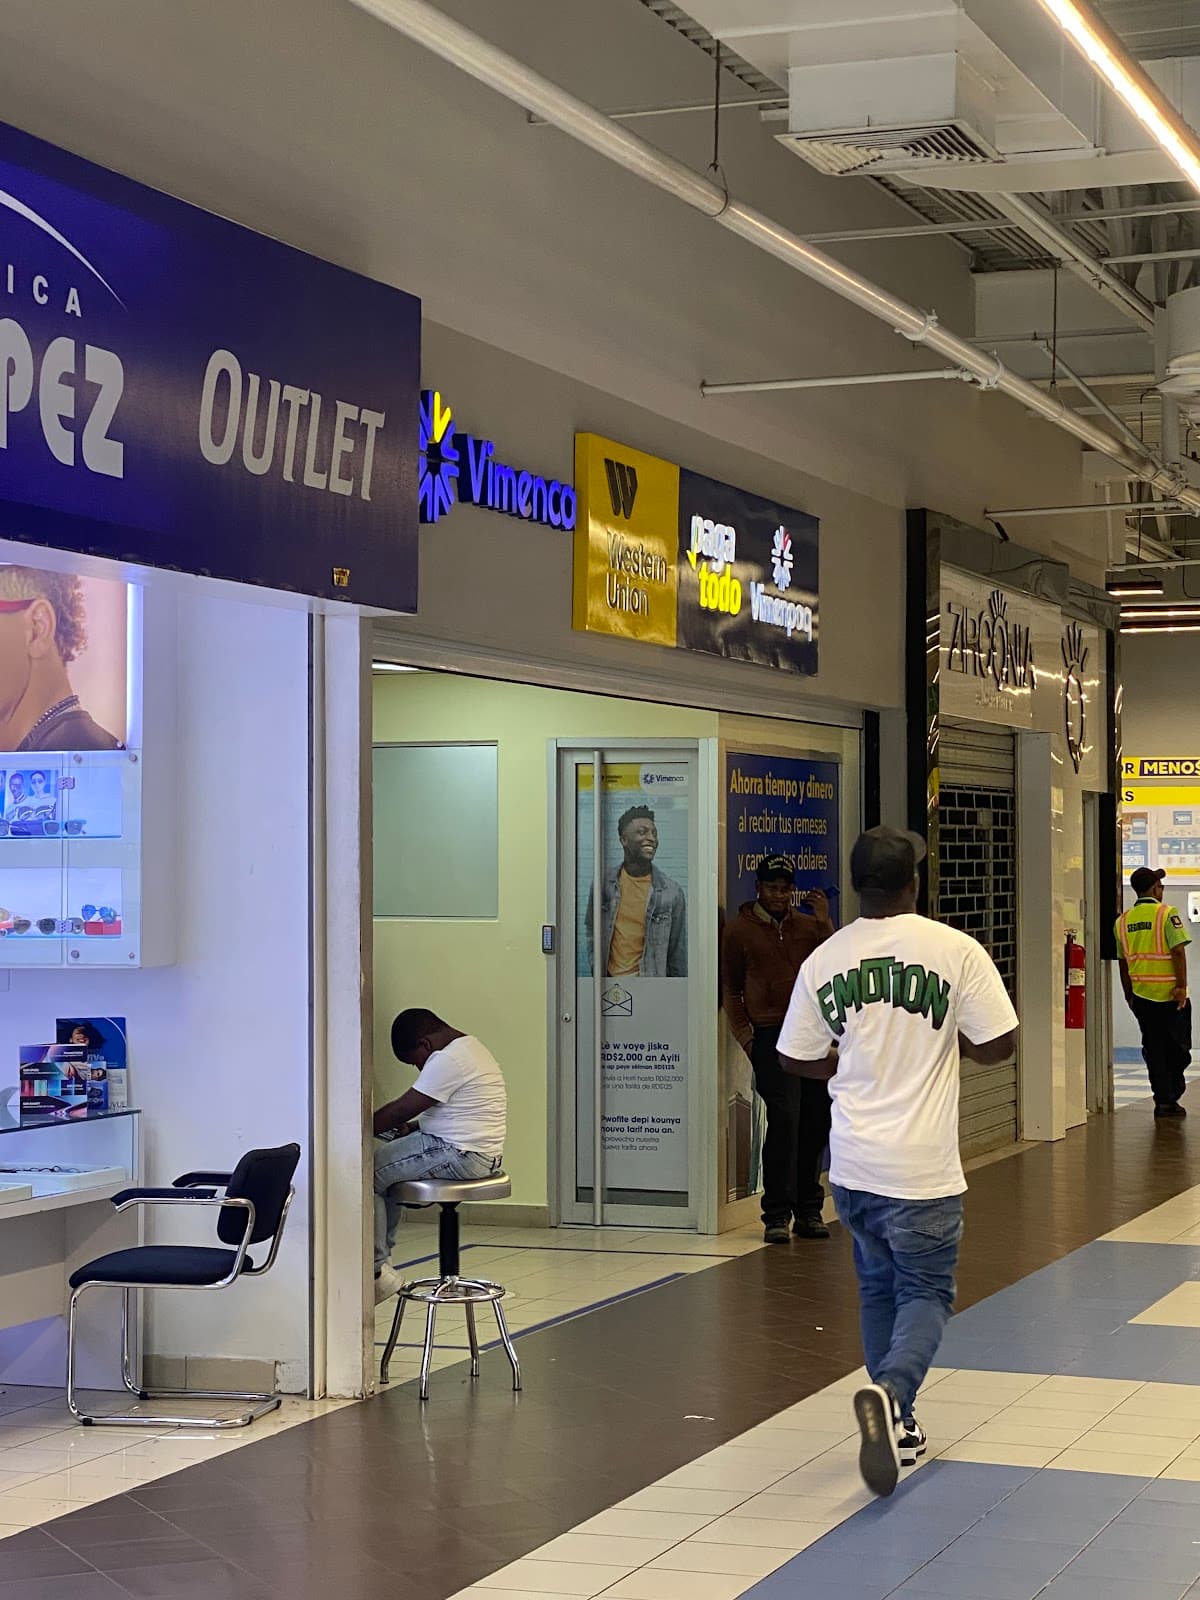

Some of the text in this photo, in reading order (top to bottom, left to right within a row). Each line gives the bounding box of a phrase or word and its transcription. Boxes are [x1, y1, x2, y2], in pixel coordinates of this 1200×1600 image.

[199, 349, 386, 501] OUTLET
[606, 527, 668, 584] Western
[690, 515, 736, 573] paga
[606, 572, 649, 616] Union
[699, 561, 742, 615] todo
[1121, 762, 1134, 774] R
[730, 768, 834, 805] Ahorra tiempo y dinero
[1121, 790, 1134, 802] S
[738, 807, 828, 835] al recibir tus remesas
[737, 853, 744, 879] y
[797, 846, 828, 871] dólares
[623, 1043, 645, 1051] voye
[647, 1042, 669, 1052] jiska
[660, 1053, 680, 1063] Ayiti
[627, 1125, 642, 1133] tarif
[631, 1116, 649, 1124] depi
[651, 1116, 681, 1125] kounya
